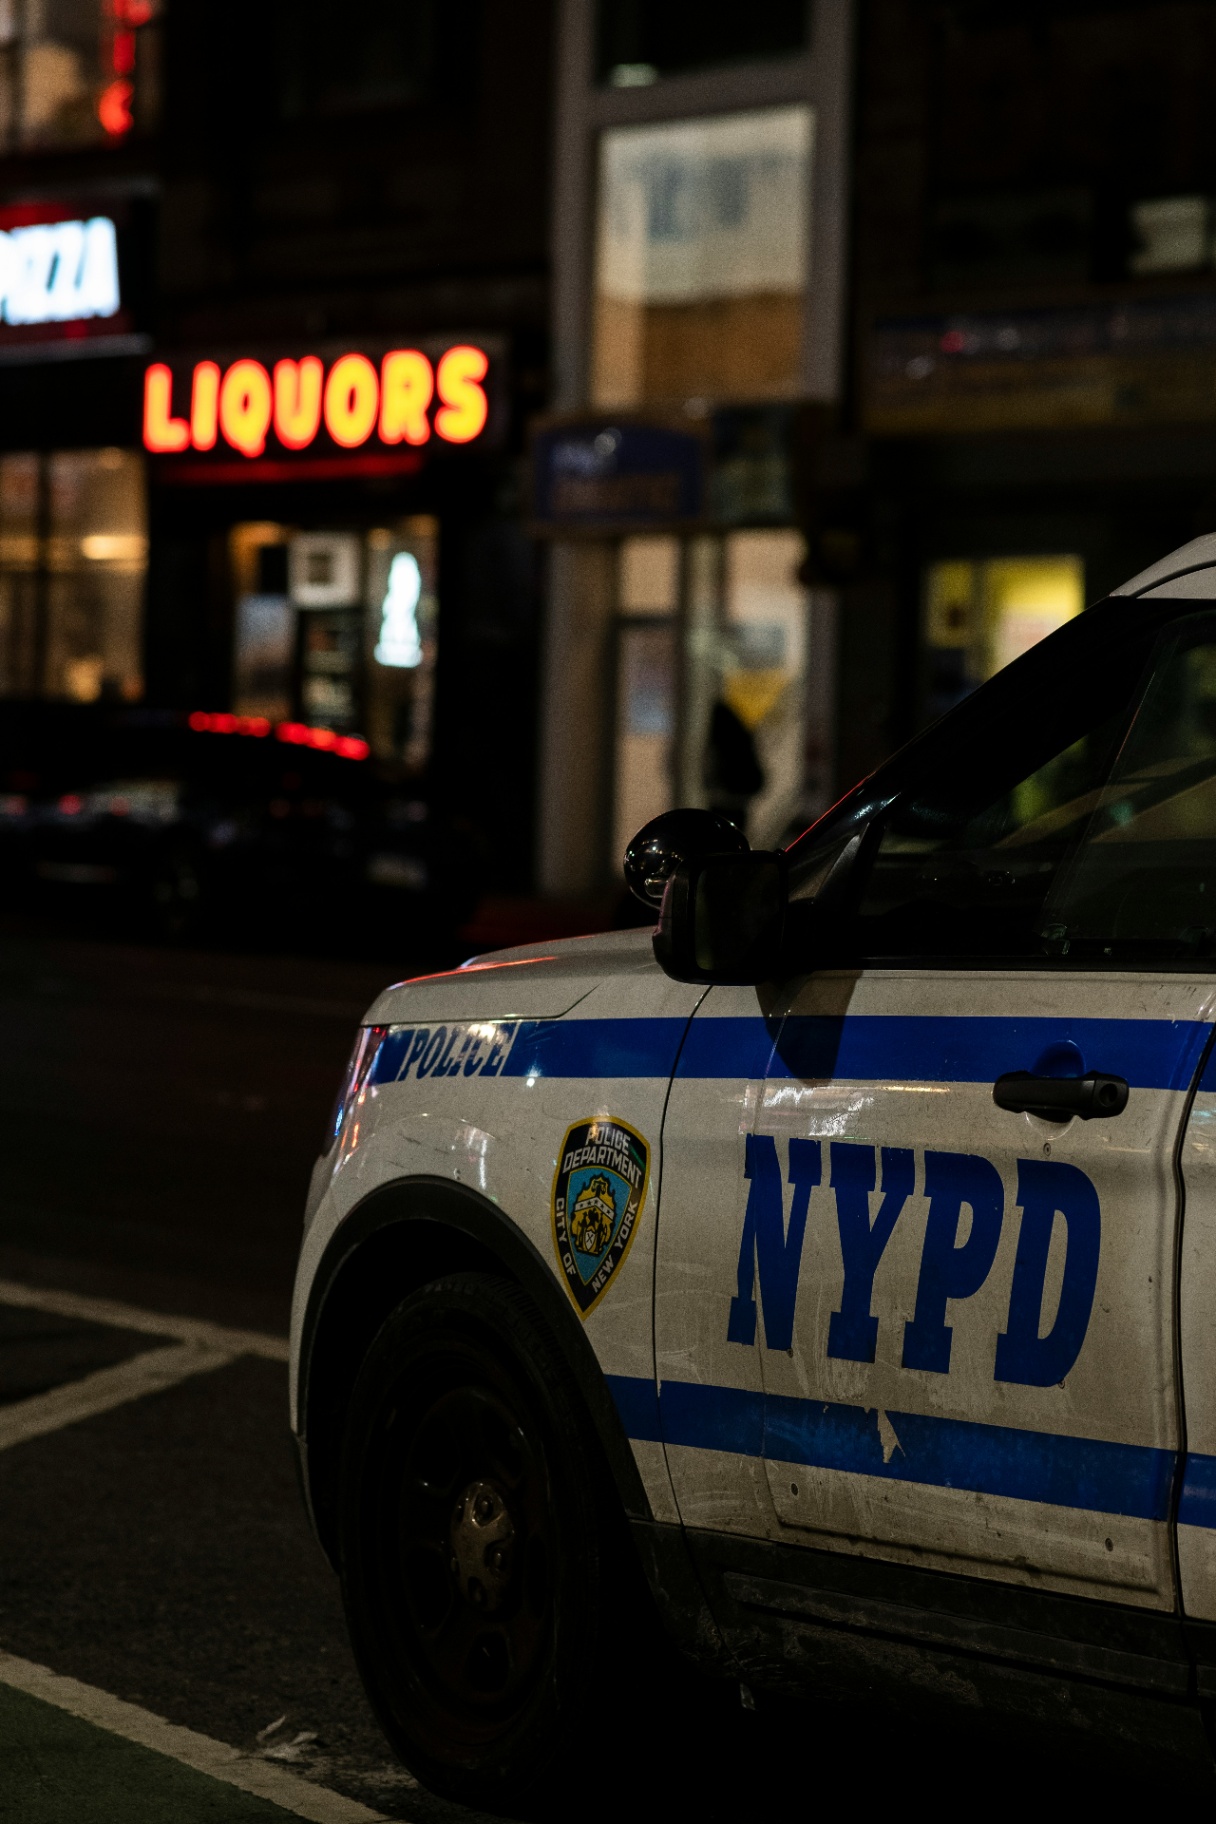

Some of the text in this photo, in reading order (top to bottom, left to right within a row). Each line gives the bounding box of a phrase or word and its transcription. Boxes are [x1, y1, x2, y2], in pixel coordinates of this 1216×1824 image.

[144, 346, 487, 456] LIQUORS
[398, 1023, 516, 1081] POLICE
[562, 1145, 642, 1189] DEPARTMENT
[585, 1126, 631, 1156] POLICE
[556, 1197, 638, 1293] CITY OF NEW YORK
[727, 1133, 1101, 1387] NYPD
